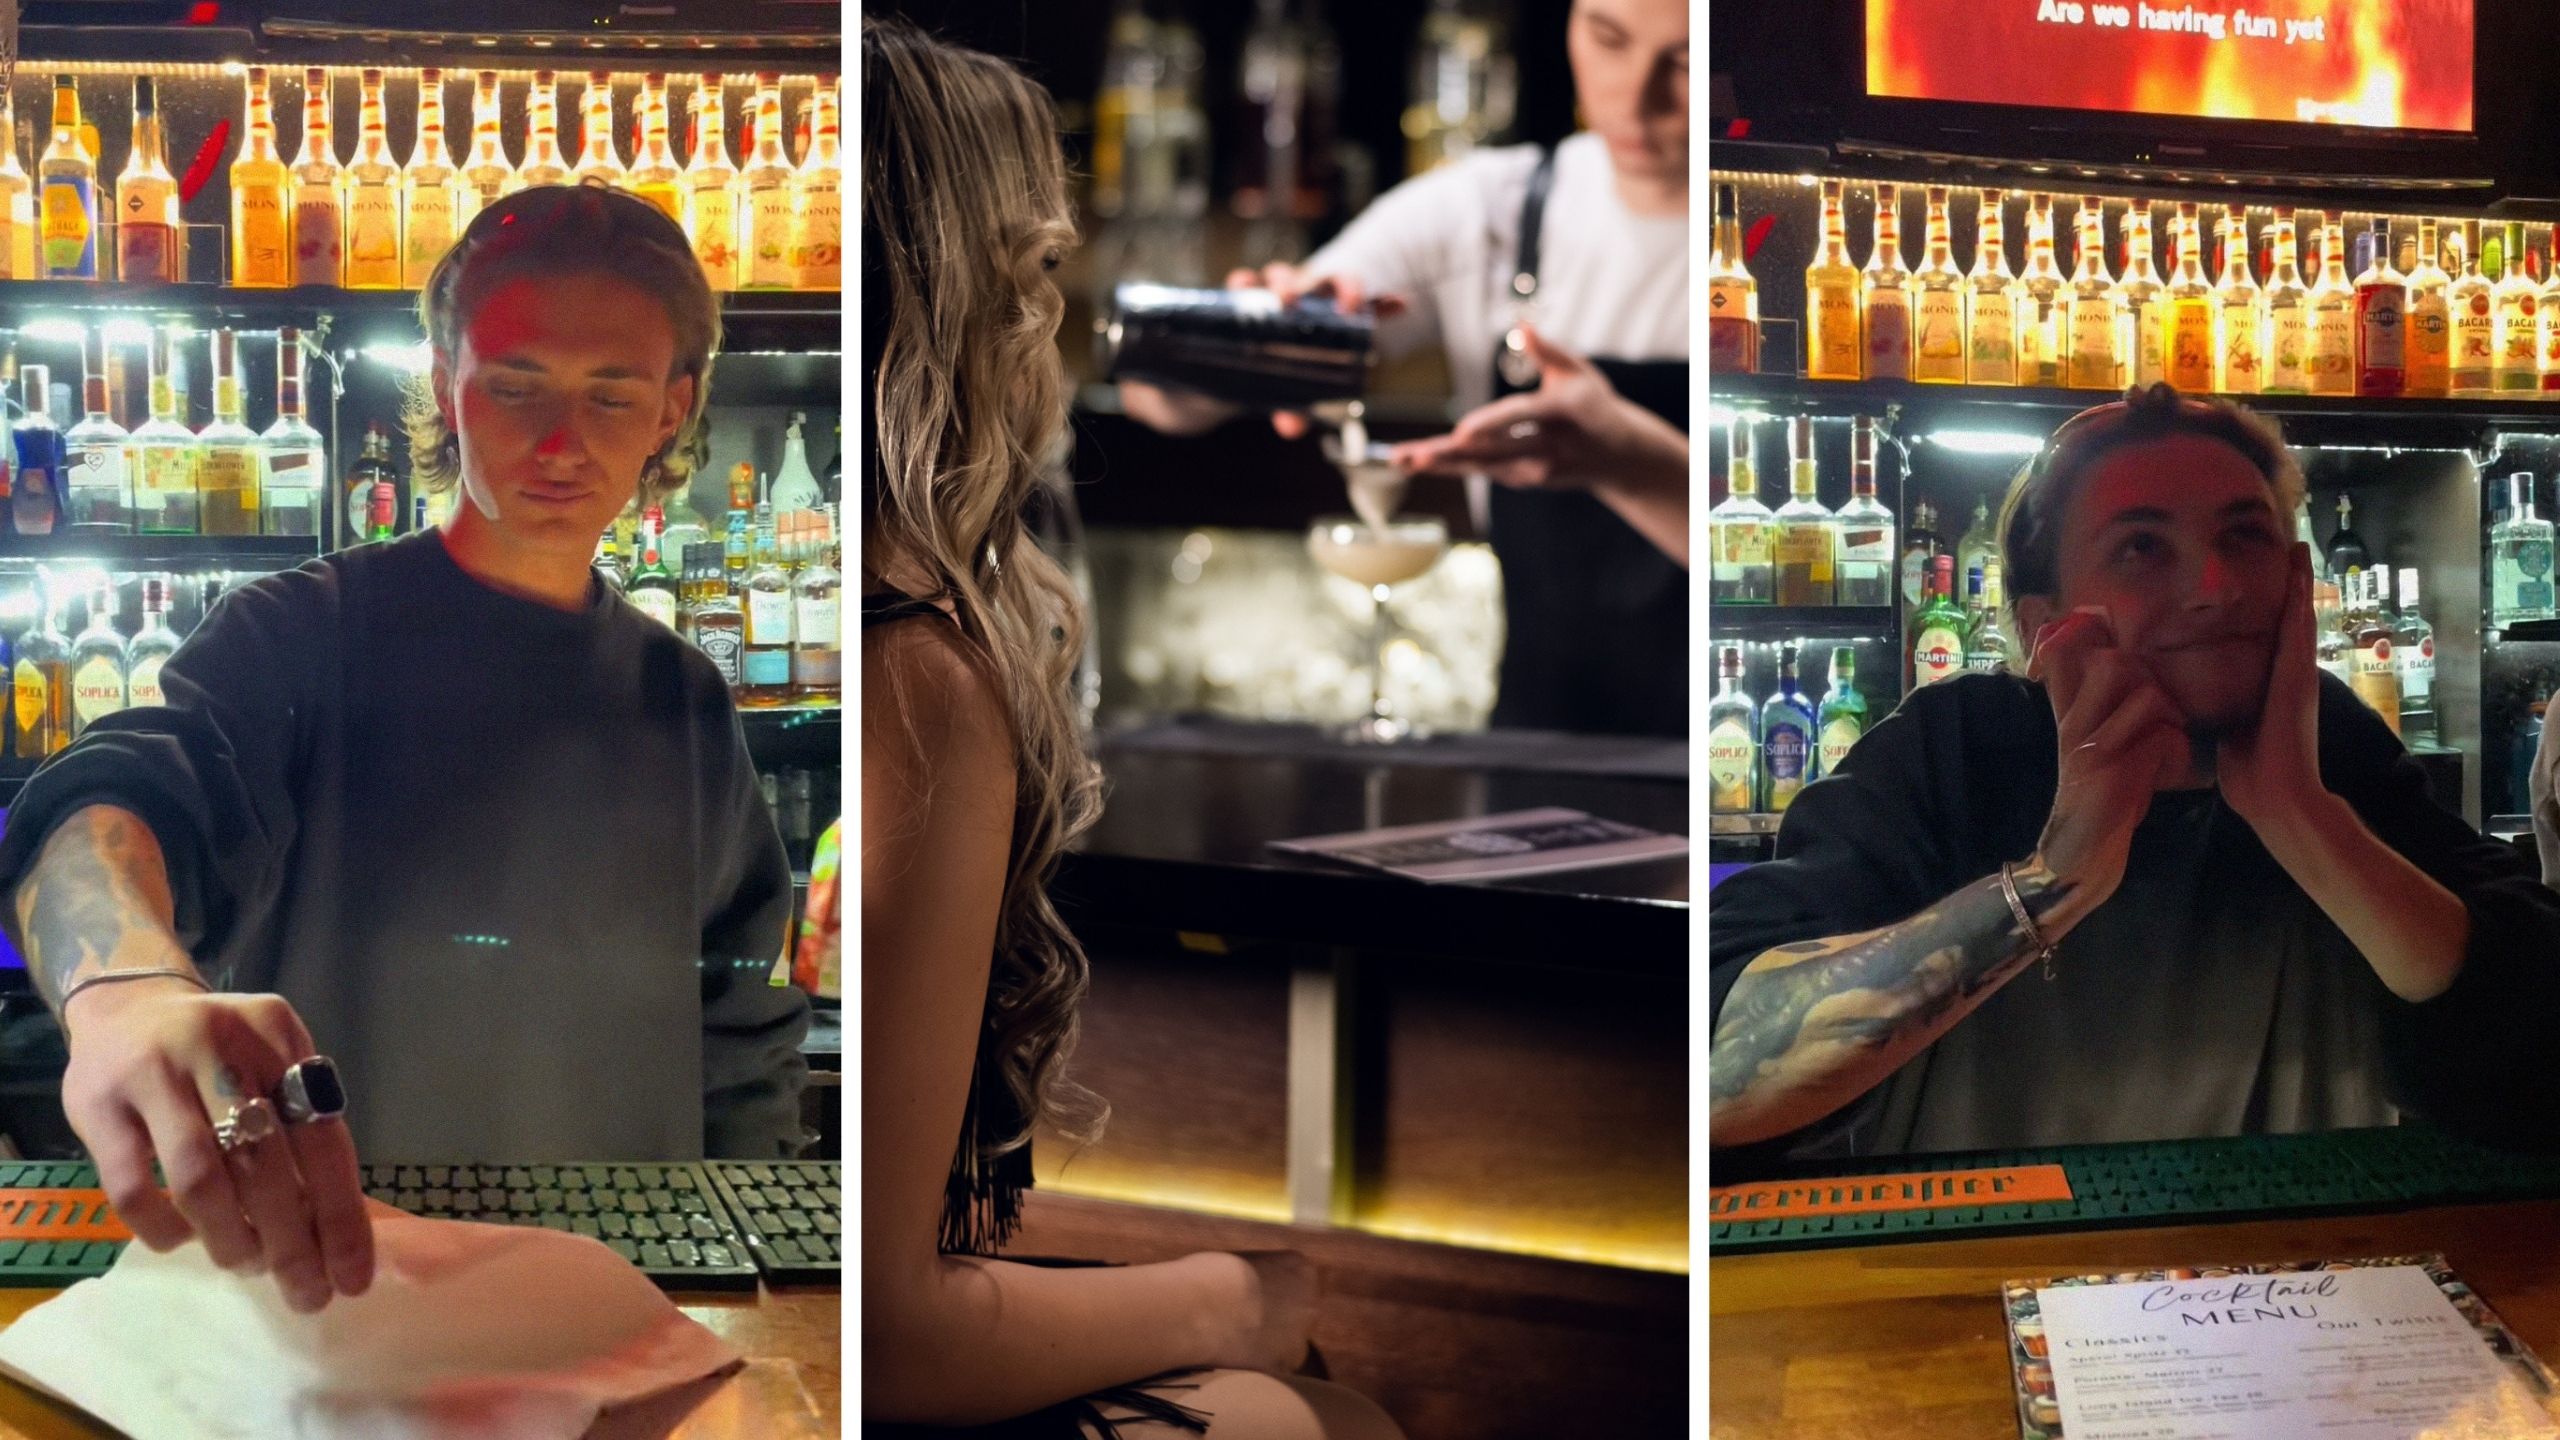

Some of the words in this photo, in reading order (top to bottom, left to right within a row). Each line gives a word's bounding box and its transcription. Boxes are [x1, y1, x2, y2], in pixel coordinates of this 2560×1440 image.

[2037, 1, 2084, 24] Are
[2092, 5, 2130, 27] we
[2138, 2, 2226, 40] having
[2234, 9, 2278, 37] fun
[2285, 16, 2325, 44] yet
[77, 686, 120, 698] SOPLICA
[2142, 1275, 2340, 1311] Cocktail
[2181, 1304, 2318, 1326] MENU
[2317, 1320, 2358, 1329] Our
[2374, 1315, 2447, 1326] Twists
[2065, 1334, 2167, 1347] Classics
